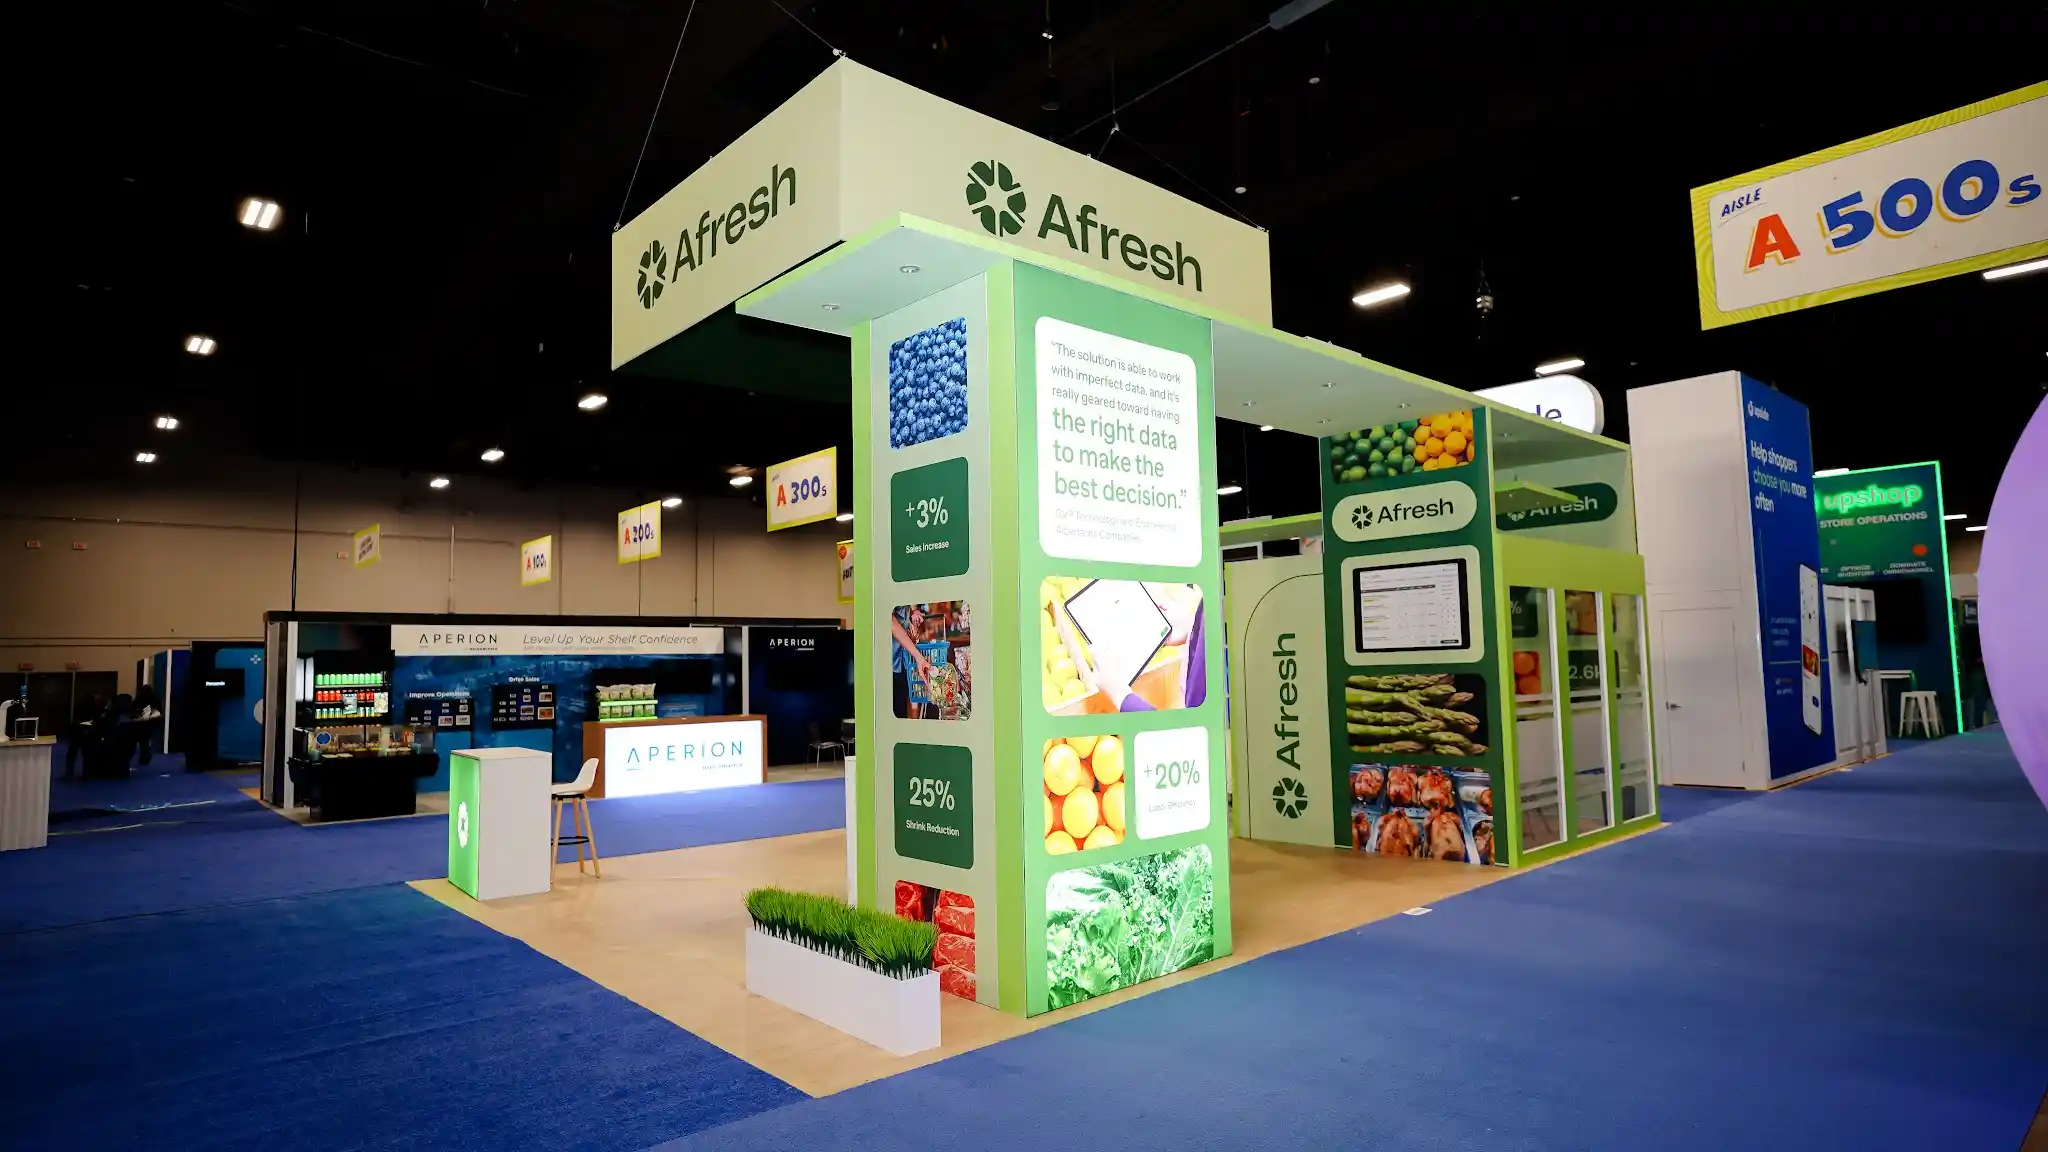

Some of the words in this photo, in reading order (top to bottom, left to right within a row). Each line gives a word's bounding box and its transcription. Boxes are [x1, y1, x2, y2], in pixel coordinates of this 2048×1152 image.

[1721, 187, 1762, 218] AISLE
[1744, 213, 1801, 273] A
[1817, 159, 2042, 255] 500s
[672, 164, 796, 283] Afresh
[1037, 193, 1203, 292] Afresh
[1051, 364, 1074, 380] with
[1075, 369, 1123, 391] imperfect
[1149, 389, 1166, 400] and
[1078, 351, 1117, 369] solution
[1118, 359, 1126, 371] is
[1127, 362, 1147, 376] able
[1148, 367, 1158, 378] to
[1159, 373, 1181, 384] work
[1052, 386, 1079, 402] really
[1081, 393, 1116, 409] geared
[1117, 400, 1149, 416] toward
[1151, 405, 1180, 424] having
[1053, 407, 1086, 433] the
[1090, 415, 1135, 445] right
[1139, 425, 1177, 450] data
[1053, 440, 1074, 463] to
[1080, 449, 1131, 473] make
[1135, 454, 1164, 478] the
[1750, 439, 1768, 466] Help
[1768, 447, 1798, 473] shoppers
[777, 484, 787, 507] A
[791, 475, 827, 504] 300s
[1055, 470, 1098, 499] best
[1753, 466, 1778, 489] choose
[1779, 478, 1791, 498] you
[1791, 482, 1807, 499] more
[905, 496, 949, 528] +3%
[1377, 498, 1454, 524] Afresh
[1754, 491, 1775, 513] often
[1823, 486, 1921, 512] upshop
[624, 527, 631, 545] A
[633, 522, 654, 543] 200s
[1820, 517, 1855, 529] STORE
[1856, 510, 1928, 526] OPERATIONS
[905, 544, 922, 554] Sales
[922, 540, 950, 552] Increase
[419, 633, 498, 644] APERION
[523, 634, 554, 644] Level
[557, 634, 574, 645] Up
[579, 634, 605, 644] Your
[607, 634, 637, 644] Shelf
[639, 633, 699, 644] Confidence
[769, 638, 815, 647] APERION
[409, 691, 436, 699] Improve
[436, 690, 471, 698] Operations
[1272, 632, 1300, 770] Afresh
[626, 740, 743, 764] APERION
[1143, 759, 1200, 790] +20%
[909, 776, 956, 811] 25%
[905, 819, 926, 832] Shrink
[926, 822, 960, 837] Reduction
